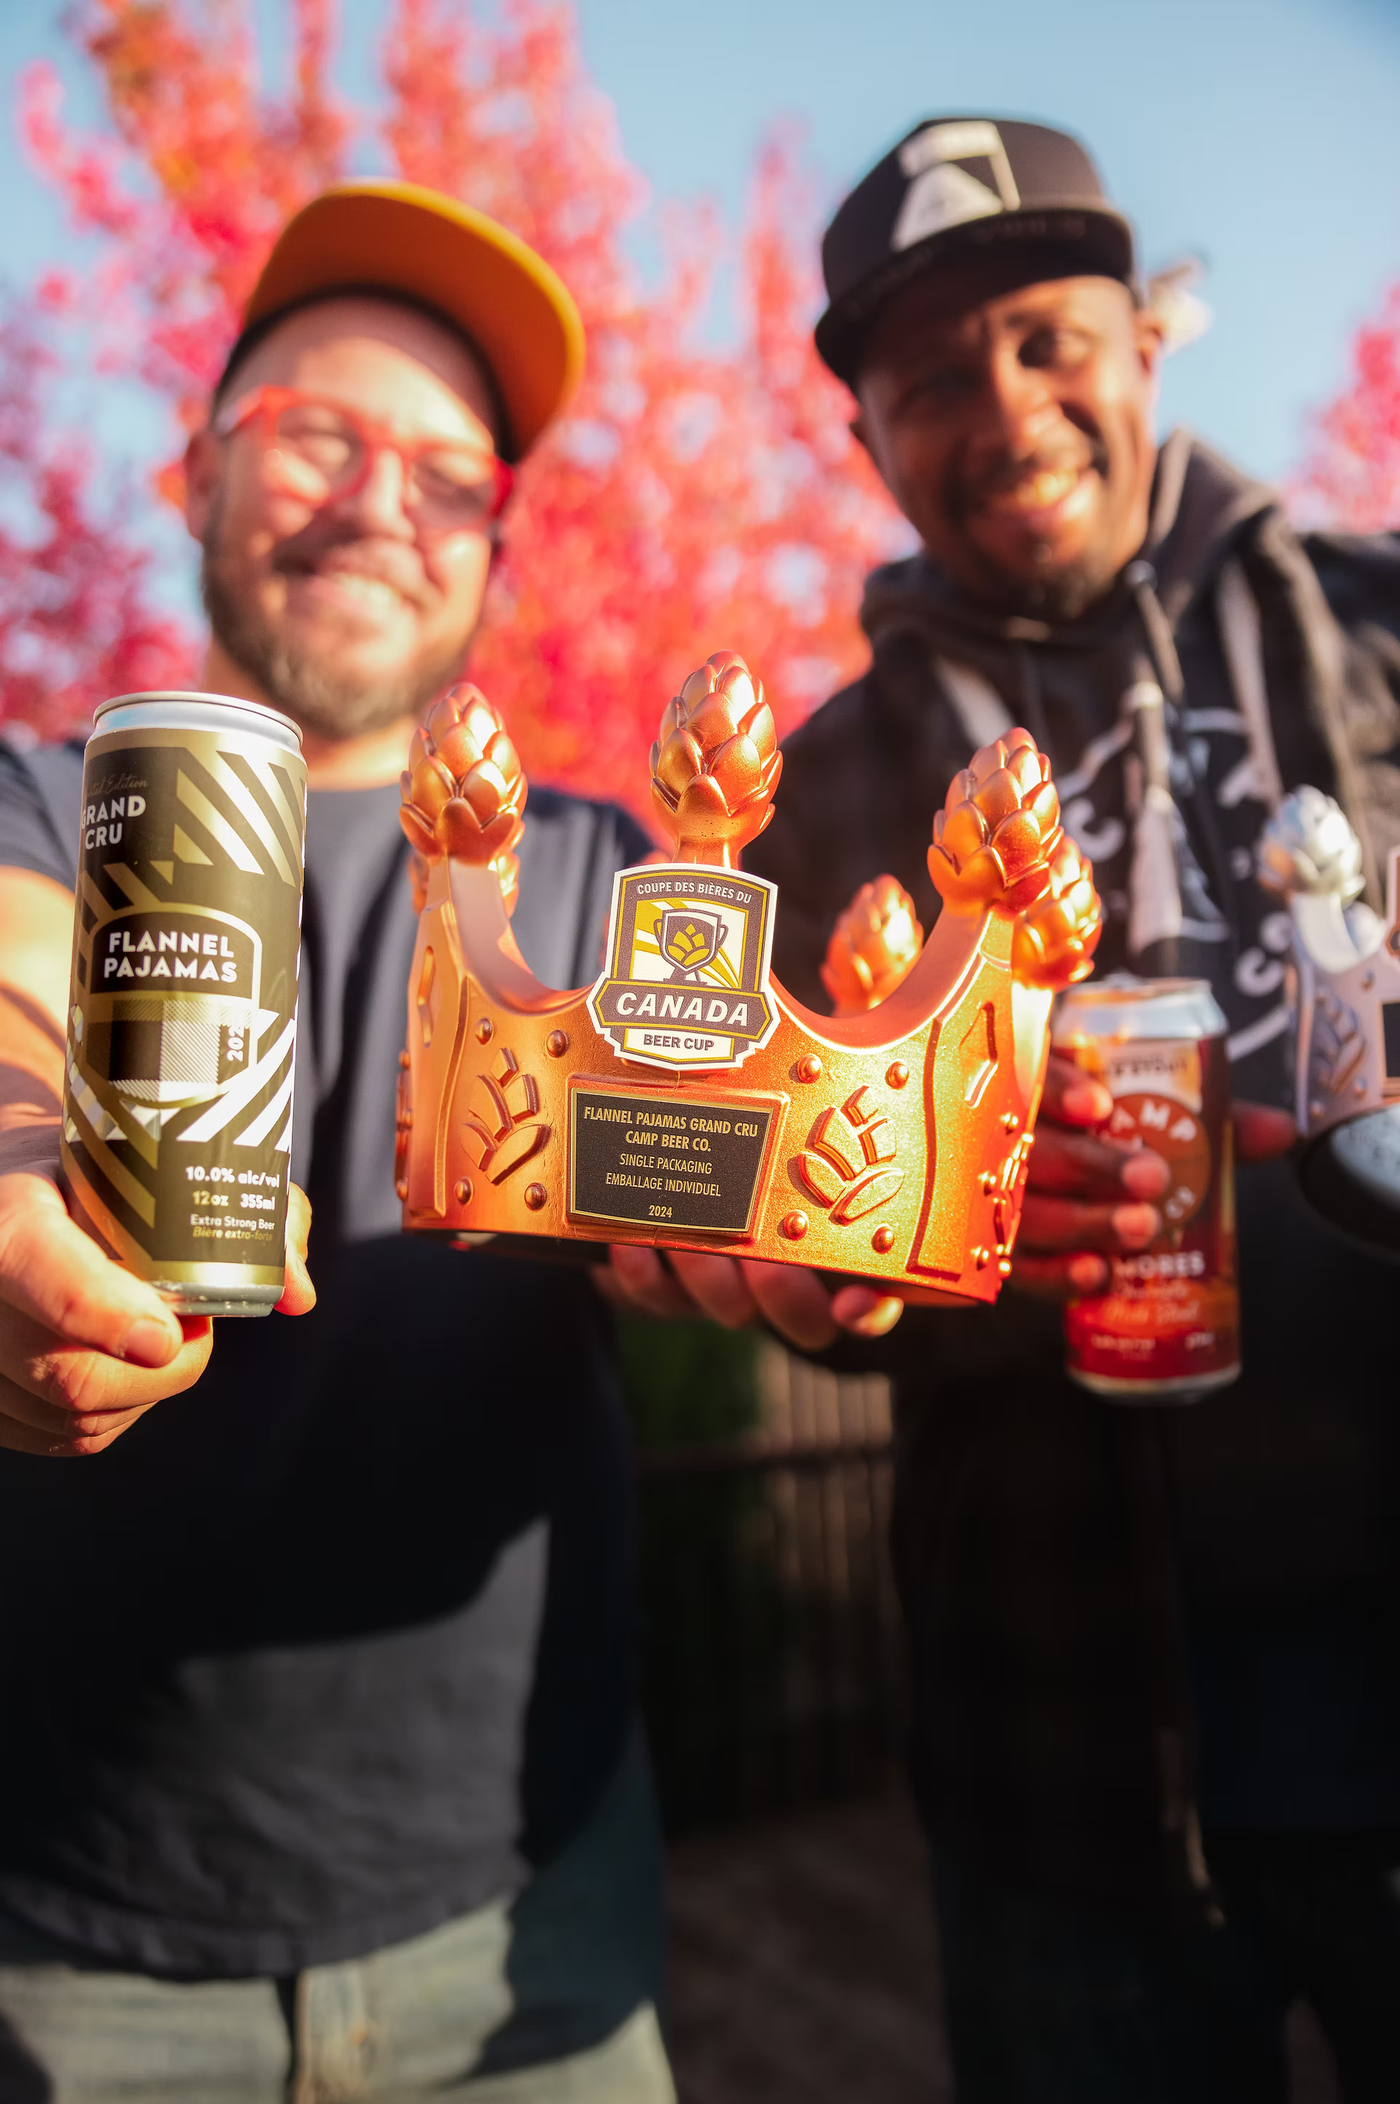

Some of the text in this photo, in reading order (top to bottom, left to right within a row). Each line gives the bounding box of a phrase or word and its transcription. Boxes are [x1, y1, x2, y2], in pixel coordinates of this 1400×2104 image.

[85, 822, 123, 850] CRU
[637, 881, 752, 904] COUPE DES BIÈRES DU
[109, 930, 235, 959] FLANNEL
[104, 955, 238, 983] PAJAMAS
[616, 992, 748, 1027] CANADA
[643, 1033, 715, 1051] BEER CUP
[584, 1106, 759, 1137] FLANNEL PAJAMAS GRAND CRU
[625, 1130, 712, 1152] CAMP BEER CO.
[619, 1153, 713, 1175] SINGLE PACKAGING
[185, 1166, 280, 1188] 10.0% alc/vol
[605, 1172, 722, 1197] EMBALLAGE INDIVIDUEL
[240, 1193, 276, 1211] 355ml
[648, 1205, 673, 1218] 2024
[190, 1213, 276, 1231] Extra Strong Beer
